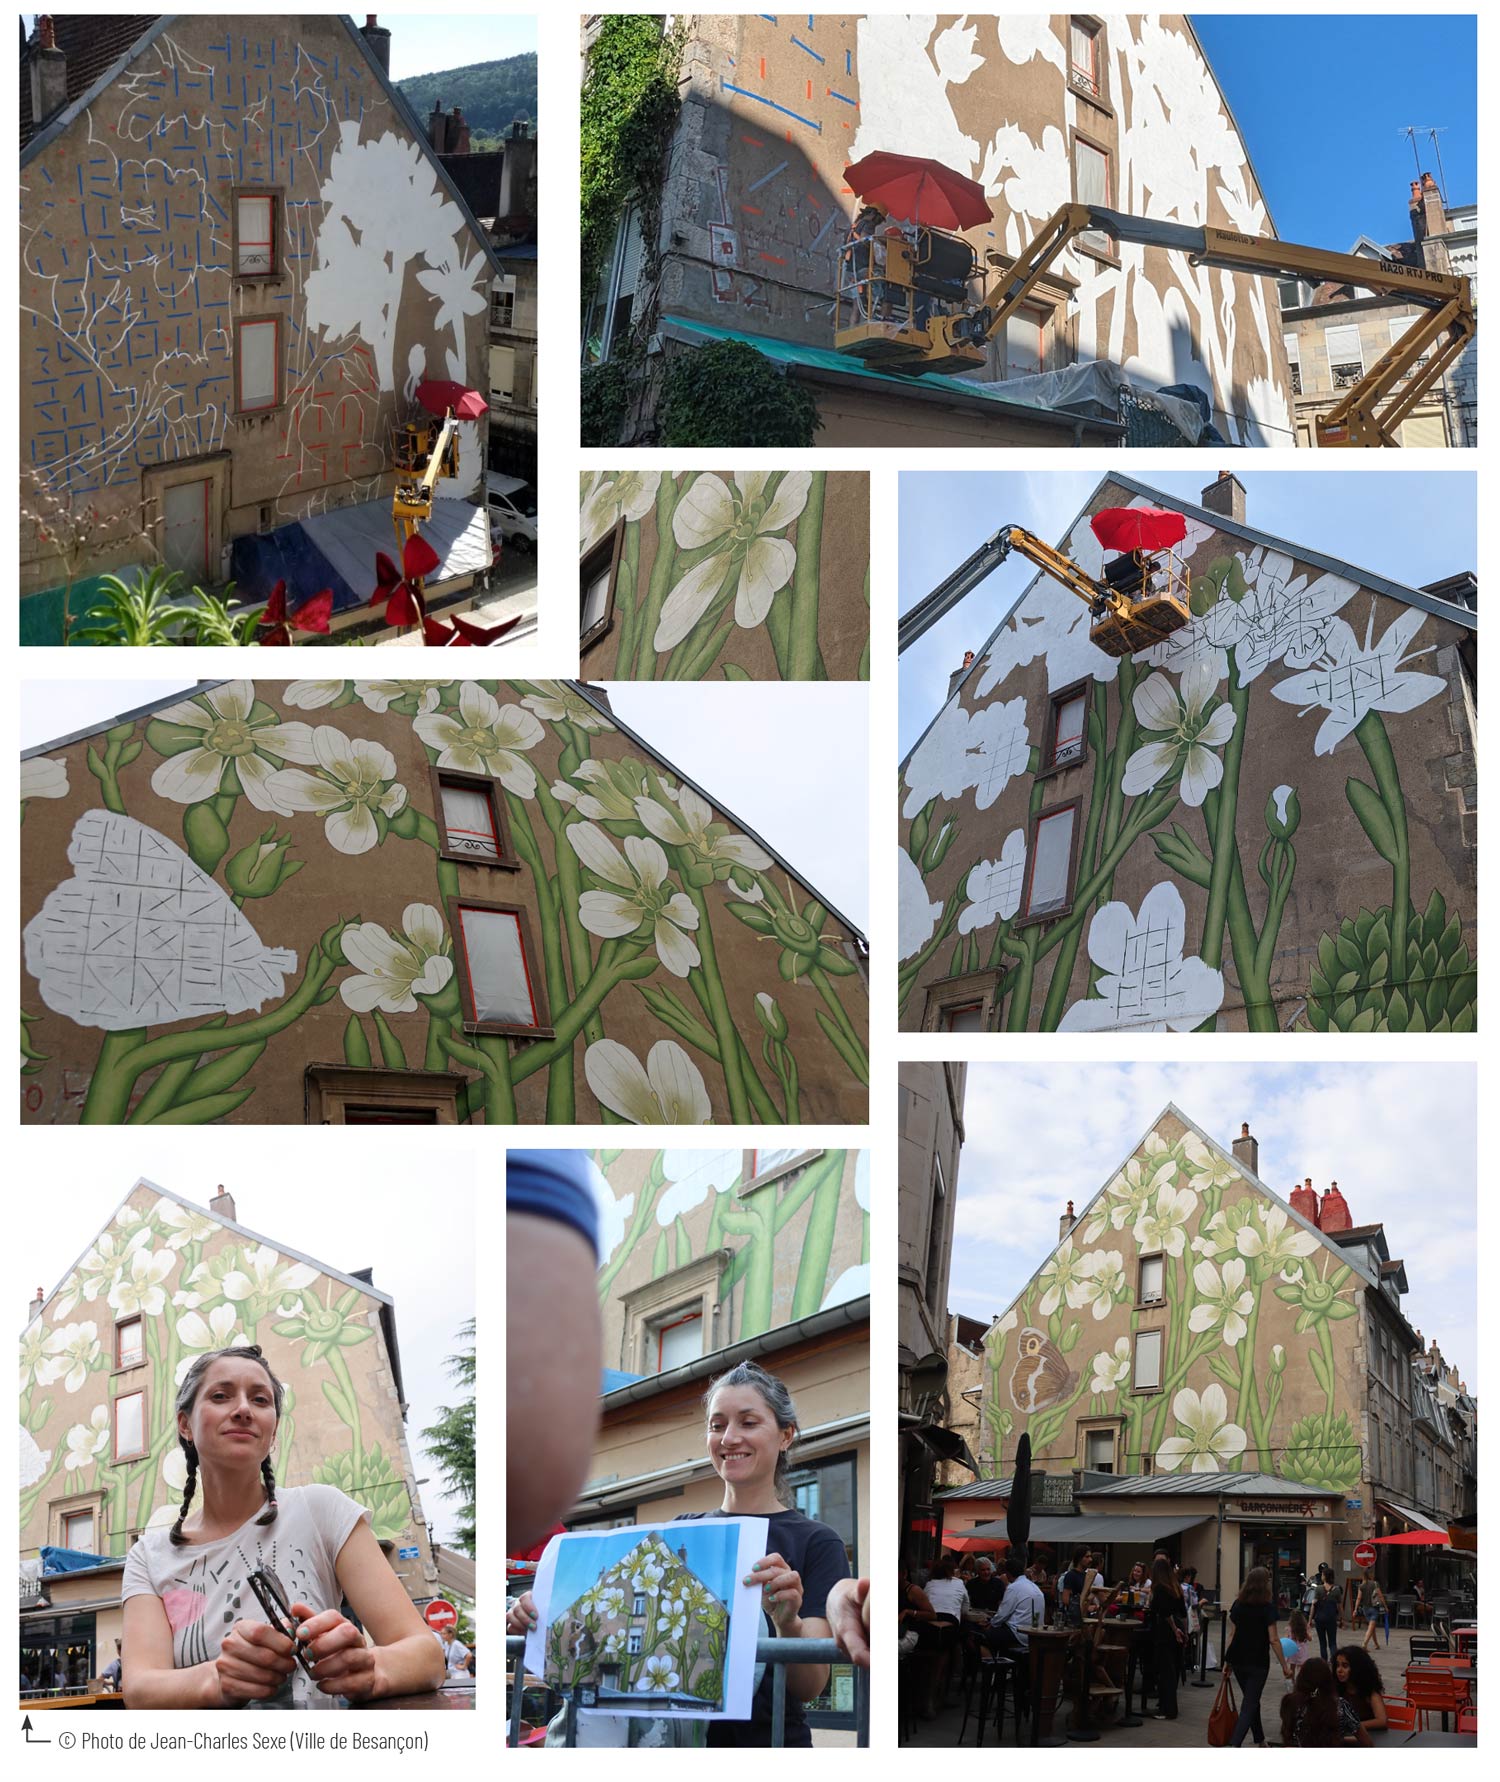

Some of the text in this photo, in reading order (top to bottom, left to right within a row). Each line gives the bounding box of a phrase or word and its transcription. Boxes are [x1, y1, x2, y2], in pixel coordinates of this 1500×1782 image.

[1380, 261, 1443, 283] HA20 RTJ PRO
